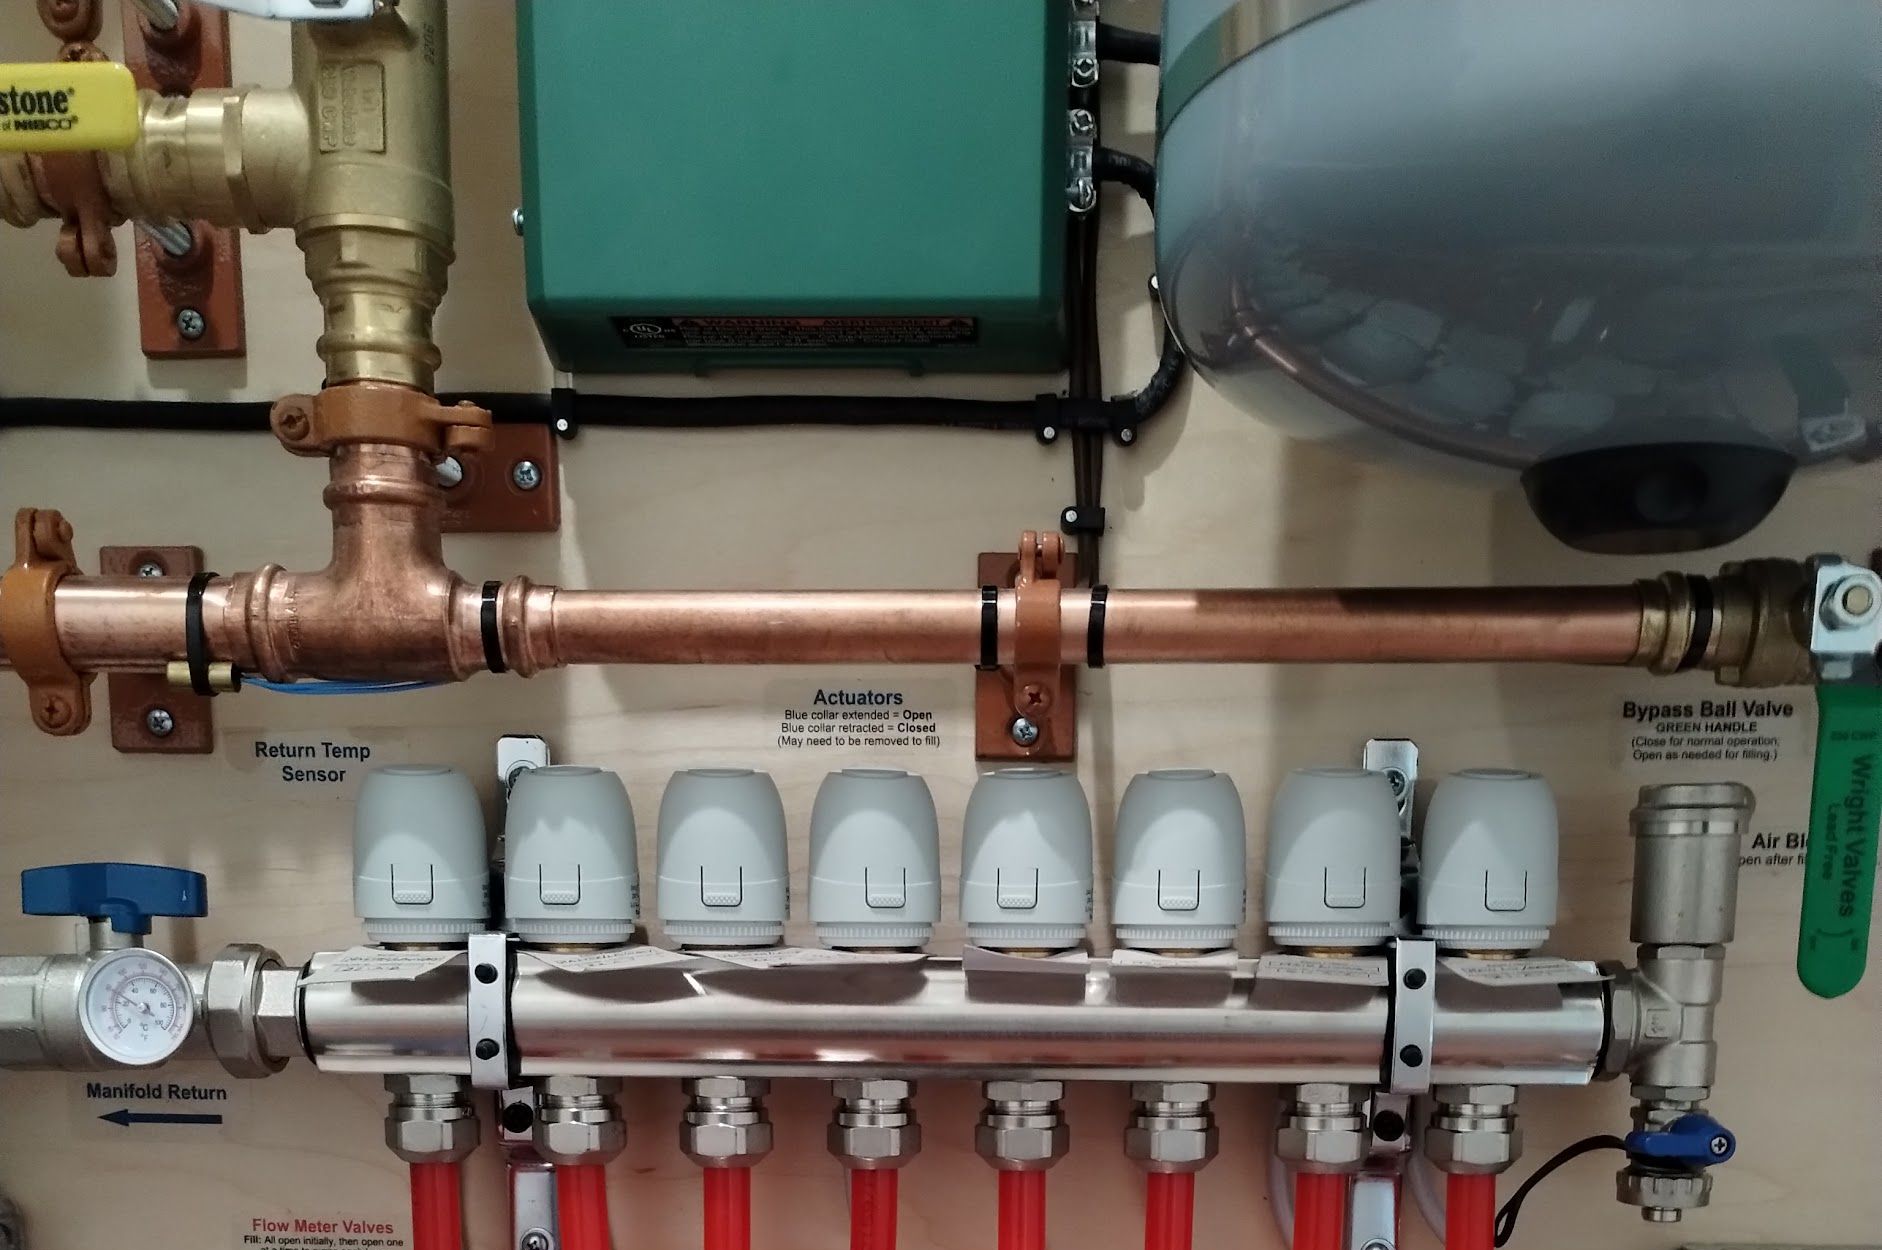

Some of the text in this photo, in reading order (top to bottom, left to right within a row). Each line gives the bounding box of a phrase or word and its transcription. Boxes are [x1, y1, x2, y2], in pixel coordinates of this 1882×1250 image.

[813, 689, 904, 706] Actuators
[784, 710, 808, 720] Blue
[811, 710, 839, 720] collar
[842, 710, 890, 720] extended
[903, 710, 933, 722] Open
[1623, 700, 1794, 723] Bypass Ball Valve
[781, 723, 805, 733] Blue
[808, 723, 837, 733] collar
[838, 723, 885, 733] retracted
[897, 723, 937, 733] Closed
[1656, 721, 1758, 733] GREEN HANDLE
[777, 736, 941, 748] (May need to be removed to fill)
[1631, 736, 1667, 747] (Close
[1670, 736, 1683, 746] for
[1687, 736, 1724, 746] normal
[255, 741, 371, 761] Return Temp
[1633, 750, 1778, 762] Open as needed for filling.)
[282, 765, 347, 782] Sensor
[1843, 753, 1874, 835] Wright
[1751, 832, 1808, 848] Air Bl
[1766, 853, 1794, 865] after
[1838, 838, 1866, 917] Valves
[86, 1082, 227, 1100] Manifold Return
[252, 1218, 394, 1234] Flow Meter Valves
[244, 1235, 404, 1247] Fill: All open initially, then open one
